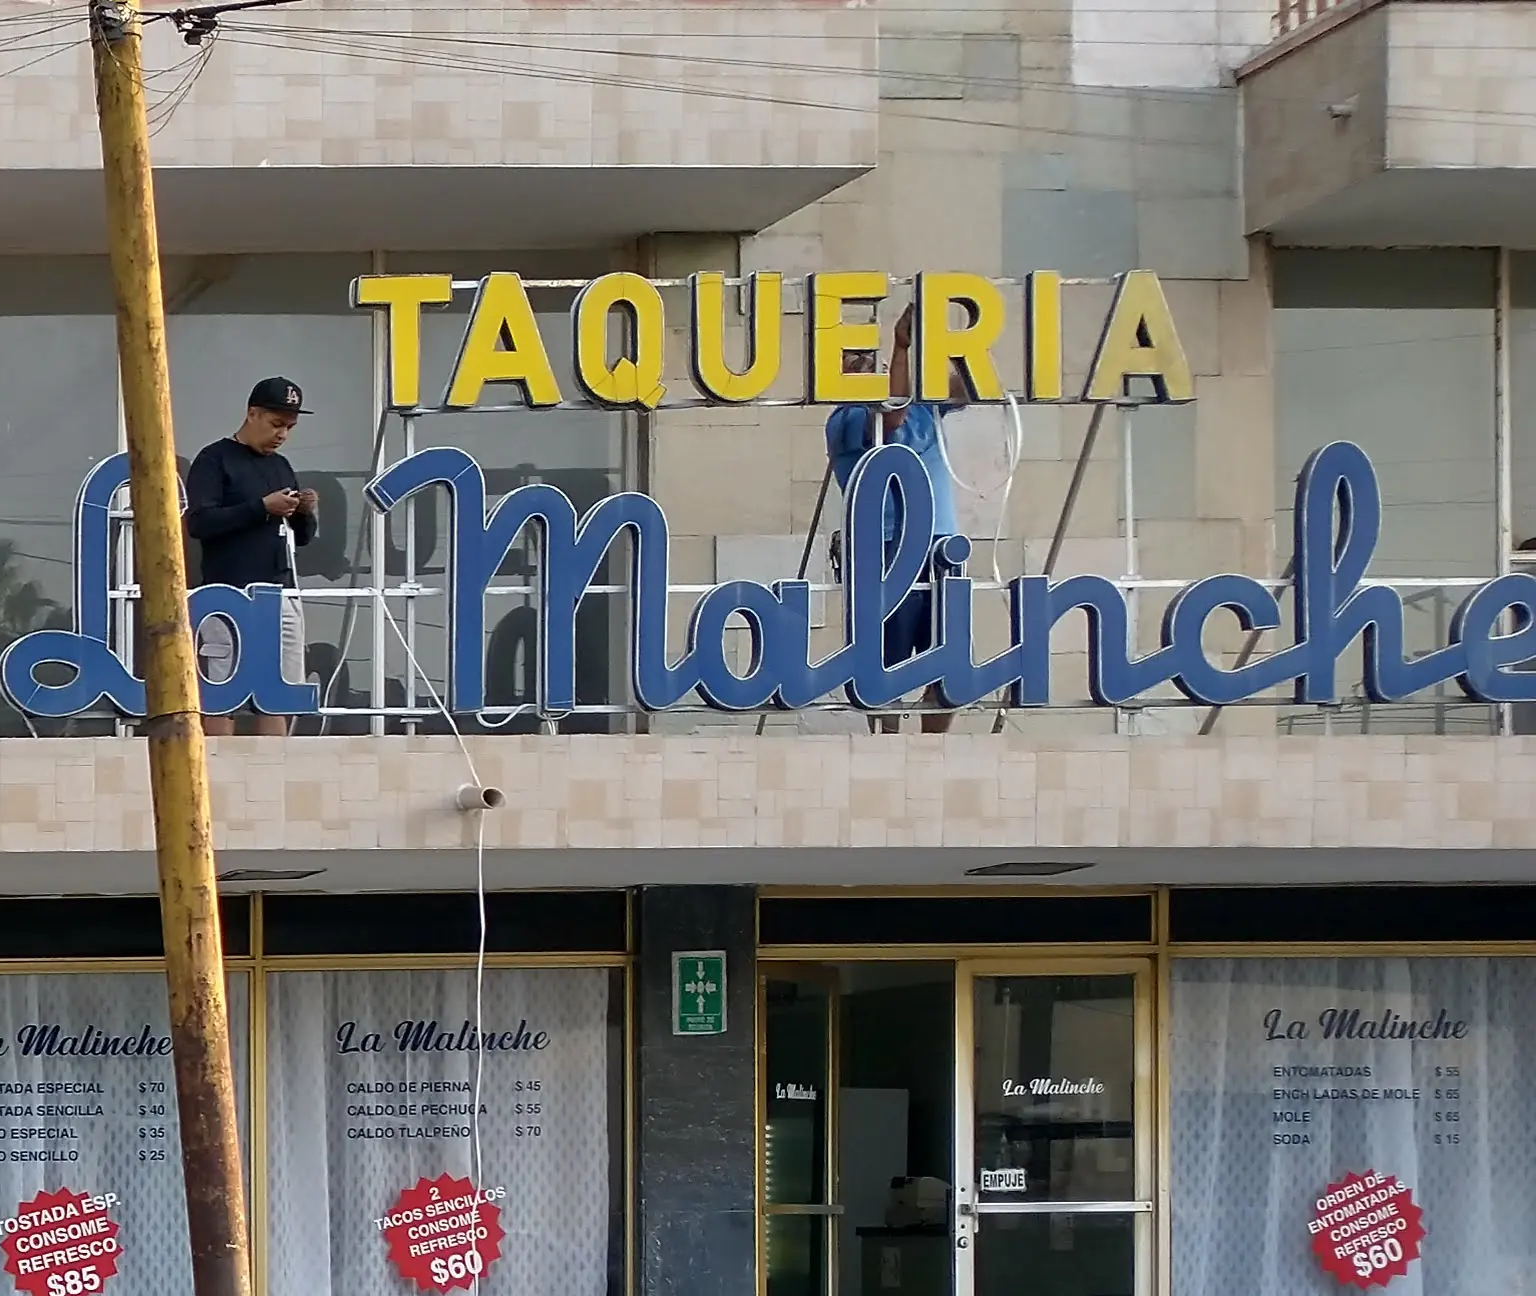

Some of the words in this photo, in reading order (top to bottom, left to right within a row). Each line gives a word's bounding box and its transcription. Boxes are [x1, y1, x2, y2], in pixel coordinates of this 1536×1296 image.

[349, 269, 1197, 414] TAQUERIA
[363, 440, 1536, 715] Malinche
[336, 1020, 386, 1054] La
[394, 1019, 551, 1052] Malinche
[1263, 1008, 1310, 1041] La
[1319, 1007, 1469, 1041] Malinche
[16, 1023, 174, 1057] Malinche
[1273, 1066, 1372, 1078] ENTOMATADAS
[37, 1082, 105, 1094] ESPECIAL
[149, 1082, 165, 1094] 70
[347, 1082, 395, 1094] CALDO
[399, 1082, 417, 1093] DE
[421, 1081, 471, 1093] PIERNA
[526, 1080, 541, 1092] 45
[1002, 1079, 1027, 1097] La
[1029, 1077, 1105, 1096] Malinche
[1361, 1088, 1379, 1100] DE
[1383, 1088, 1421, 1100] MOLE
[37, 1105, 105, 1117] SENCILLA
[149, 1105, 165, 1116] 40
[347, 1104, 395, 1116] CALDO
[399, 1104, 417, 1116] DE
[526, 1103, 541, 1115] 55
[1273, 1111, 1311, 1123] MOLE
[11, 1128, 78, 1140] ESPECIAL
[149, 1127, 165, 1139] 35
[347, 1126, 395, 1139] CALDO
[399, 1124, 471, 1138] TLALPEÑO
[526, 1126, 541, 1138] 70
[1273, 1133, 1311, 1145] SODA
[11, 1151, 79, 1162] SENCILLO
[149, 1150, 165, 1162] 25
[429, 1187, 441, 1201] 2
[983, 1173, 1024, 1188] EMPUJE
[1316, 1181, 1365, 1211] ORDEN
[1364, 1171, 1386, 1189] DE
[81, 1192, 122, 1214] ESP.
[374, 1208, 424, 1231] TACOS
[426, 1186, 507, 1217] SENCILLOS
[1307, 1180, 1407, 1235] ENTOMATADAS
[15, 1216, 110, 1253] CONSOME
[407, 1211, 482, 1239] CONSOME
[1330, 1202, 1400, 1242] CONSOME
[409, 1226, 489, 1258] REFRESCO
[1334, 1218, 1407, 1260] REFRESCO
[17, 1237, 118, 1275] REFRESCO
[430, 1249, 484, 1286] $60
[1353, 1237, 1403, 1279] $60
